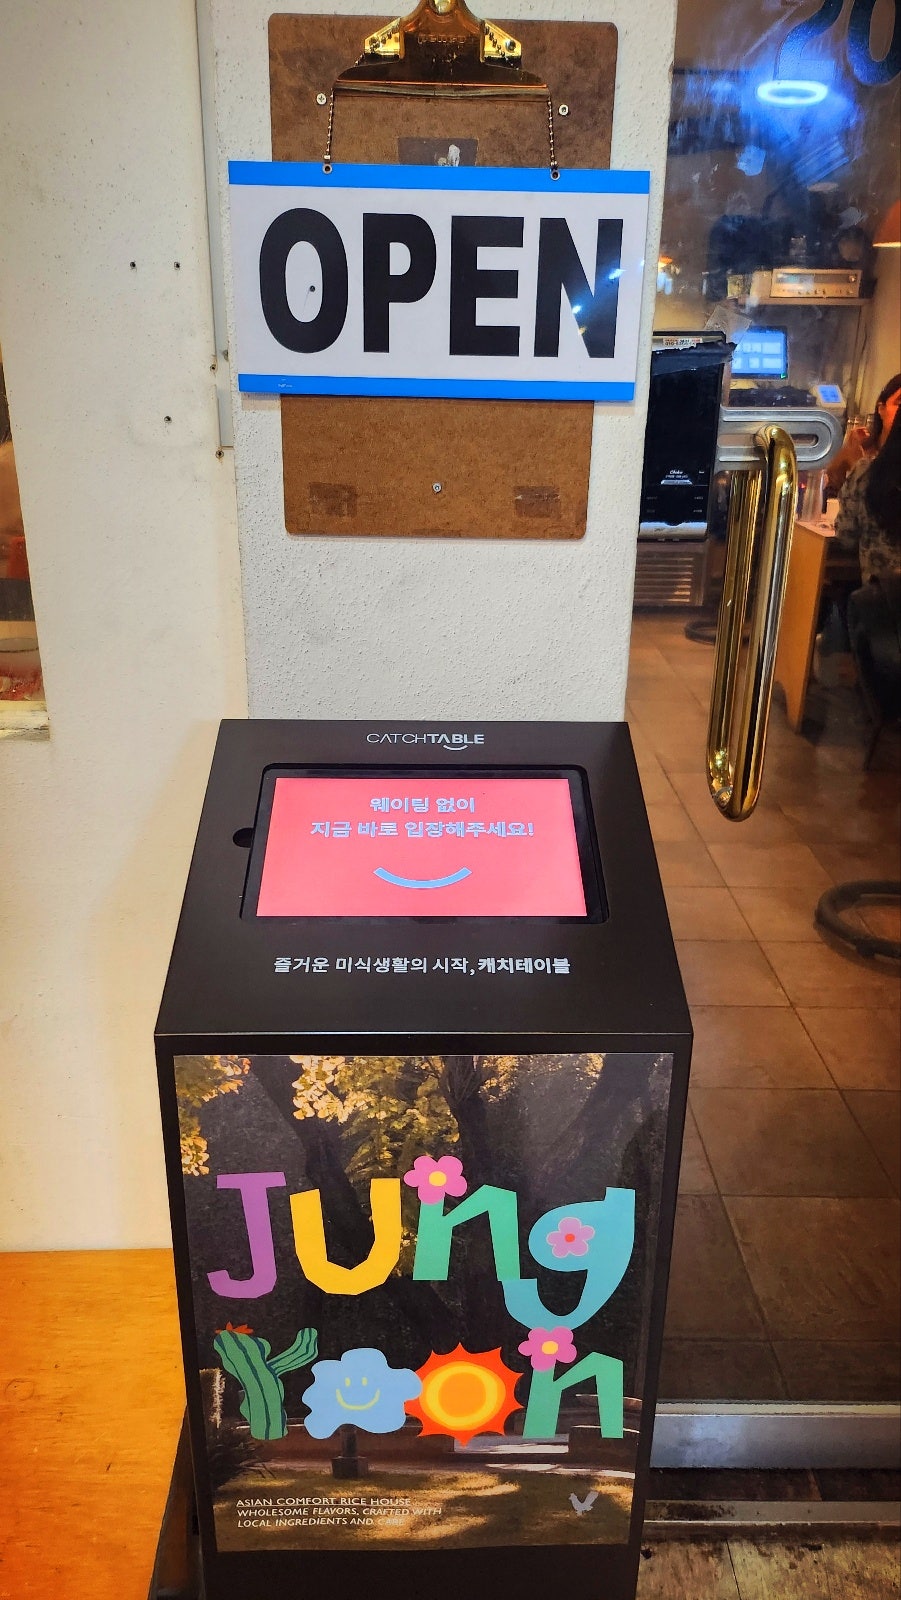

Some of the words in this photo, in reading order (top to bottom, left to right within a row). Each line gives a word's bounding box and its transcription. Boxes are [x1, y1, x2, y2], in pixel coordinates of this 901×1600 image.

[259, 207, 624, 358] OPEN
[366, 733, 485, 745] CATCHTABLE
[369, 797, 430, 813] 웨이팅
[435, 797, 475, 813] 없이
[310, 821, 352, 838] 지금
[357, 821, 399, 838] 바로
[404, 821, 535, 838] 입장해주세요!
[273, 956, 330, 973] 즐거운
[335, 956, 428, 974] 미식생활의
[432, 957, 475, 976] 시작,
[477, 957, 571, 974] 캐치테이블
[236, 1498, 273, 1507] ASIAN
[276, 1497, 337, 1506] COMFORT
[340, 1497, 367, 1506] RICE
[370, 1498, 411, 1506] HOUSE
[237, 1507, 309, 1517] WHOLESOME
[362, 1507, 410, 1516] CRAFTED
[412, 1507, 442, 1516] WITH
[237, 1519, 272, 1528] LOCAL
[275, 1517, 348, 1527] INGREDIENTS
[349, 1517, 374, 1526] AND
